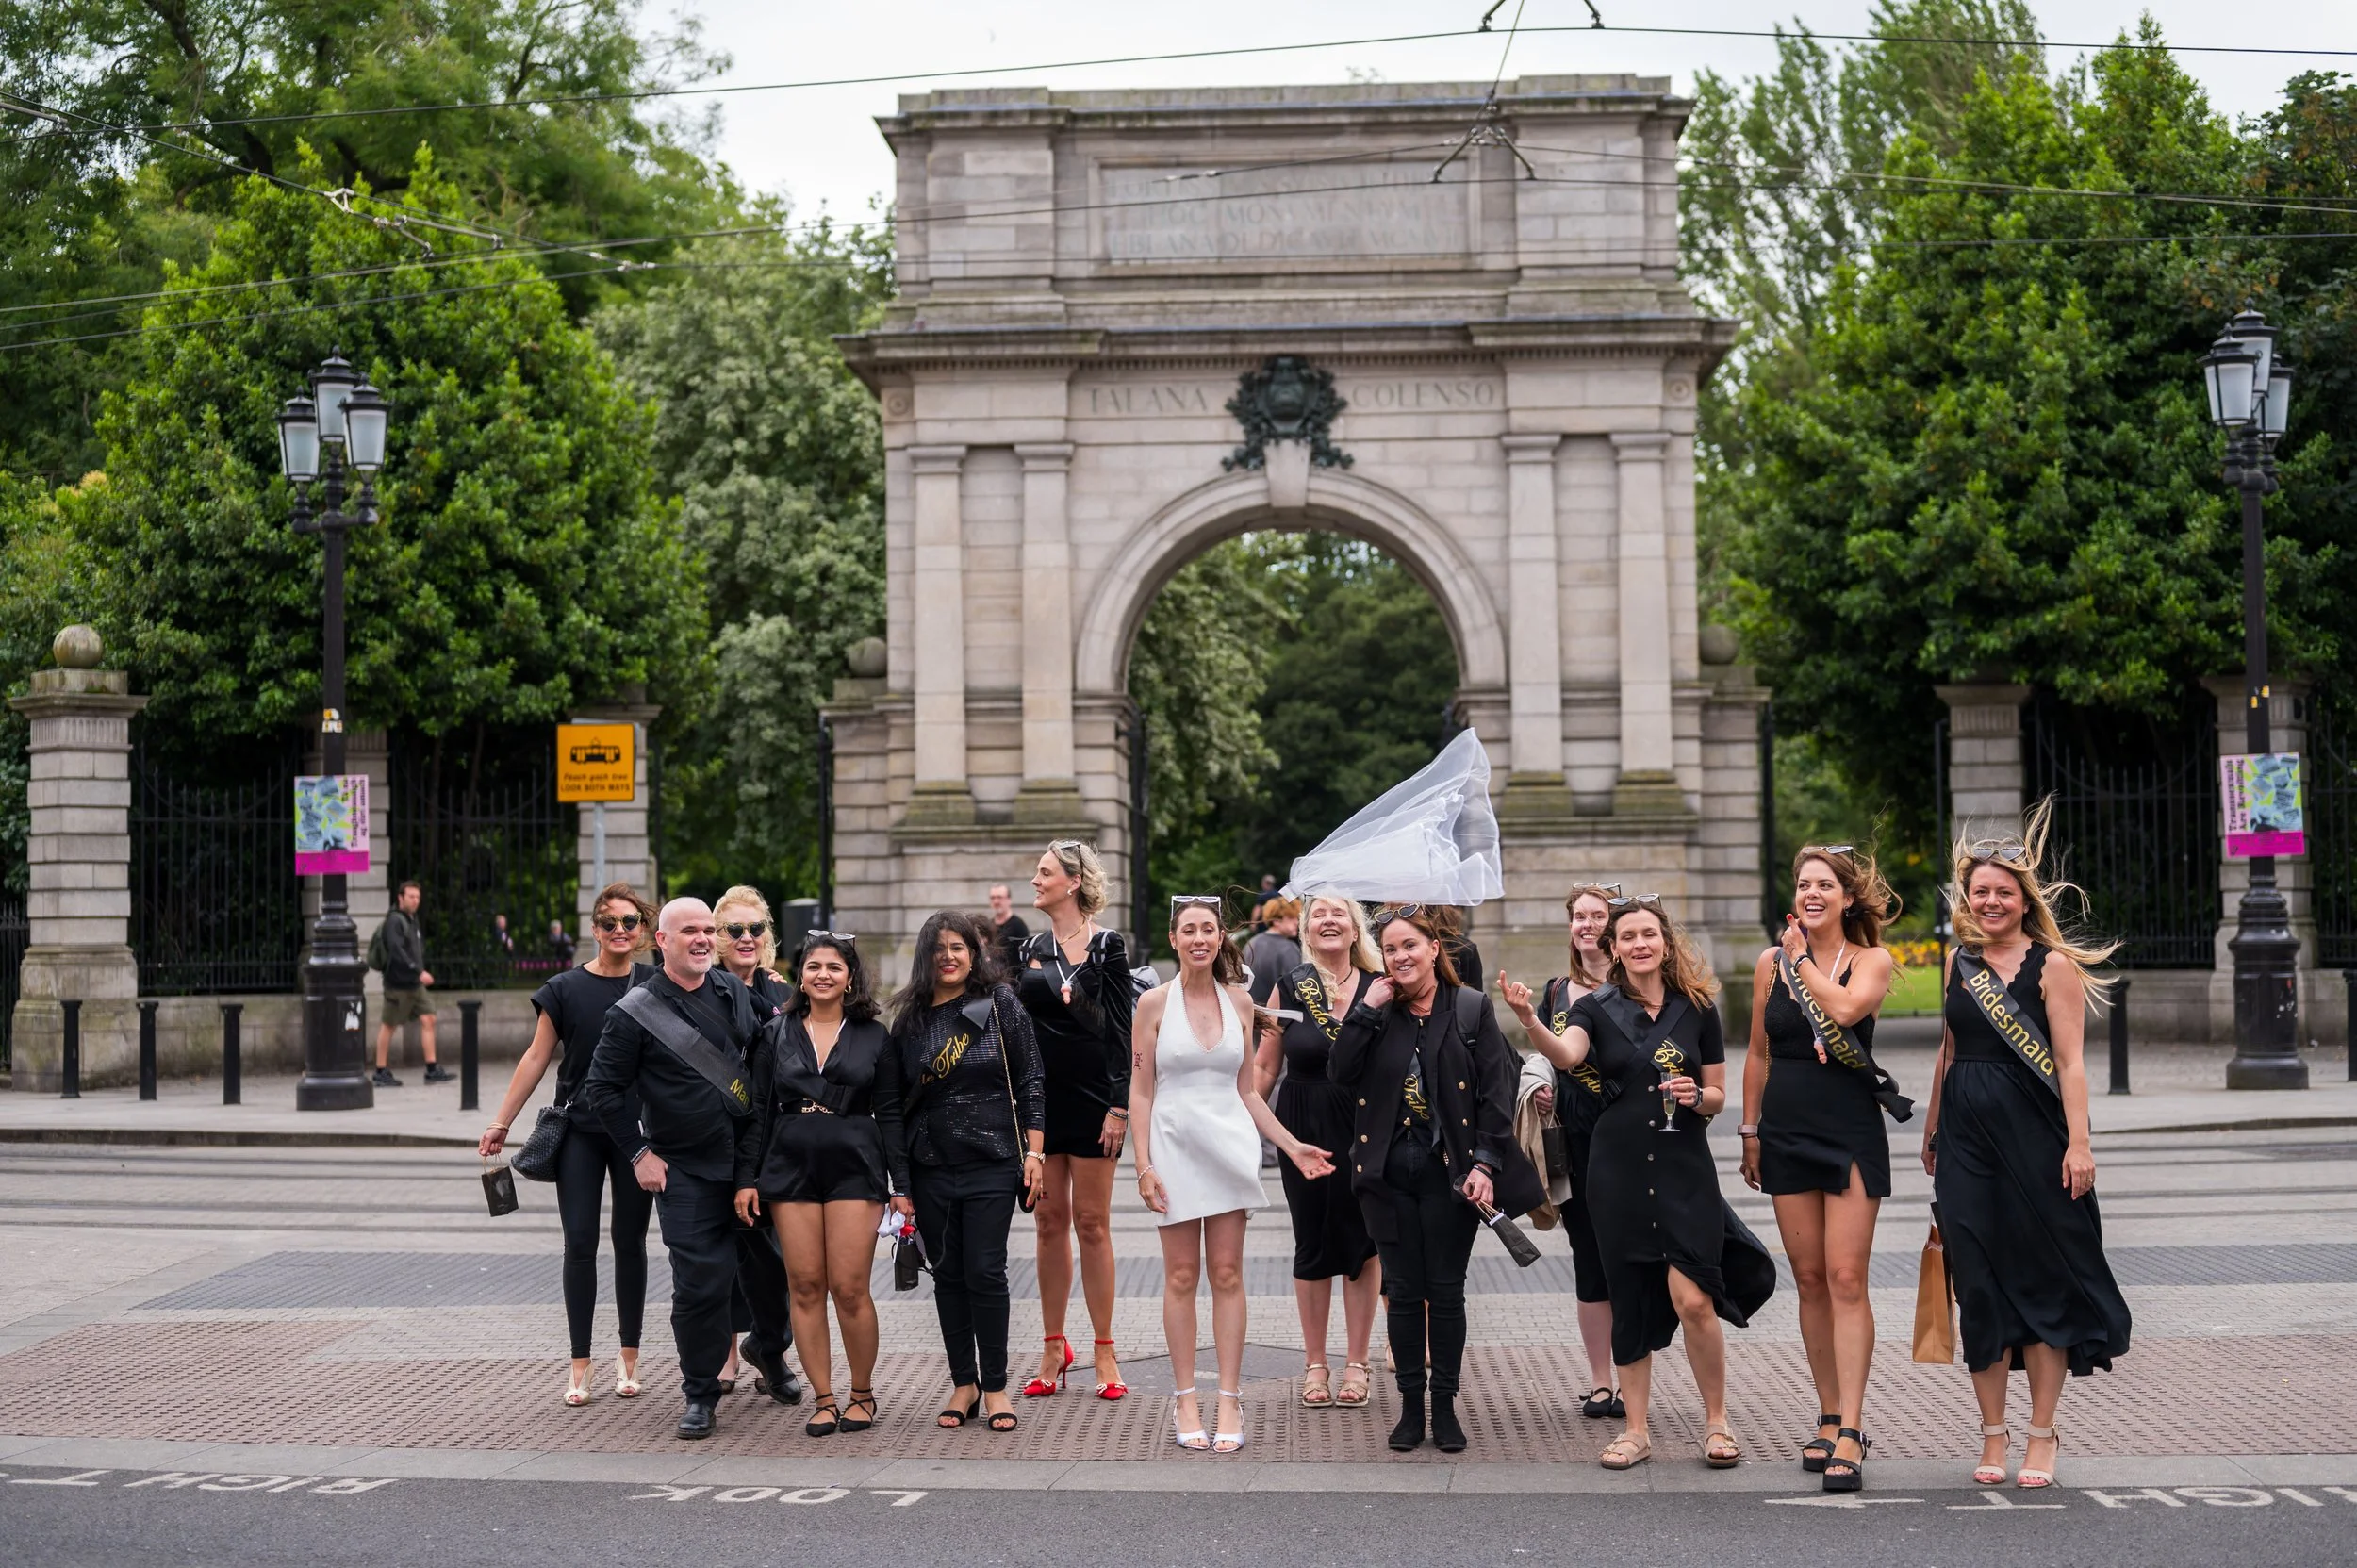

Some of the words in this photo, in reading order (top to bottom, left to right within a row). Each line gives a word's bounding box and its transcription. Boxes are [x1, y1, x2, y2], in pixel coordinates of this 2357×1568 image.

[1352, 381, 1494, 407] COLENSO
[1297, 977, 1331, 1025] Bride
[933, 1033, 969, 1078] Tribe
[1404, 1073, 1430, 1120] Tribe
[9, 1469, 400, 1494] RIGHT
[628, 1484, 929, 1507] LOOK
